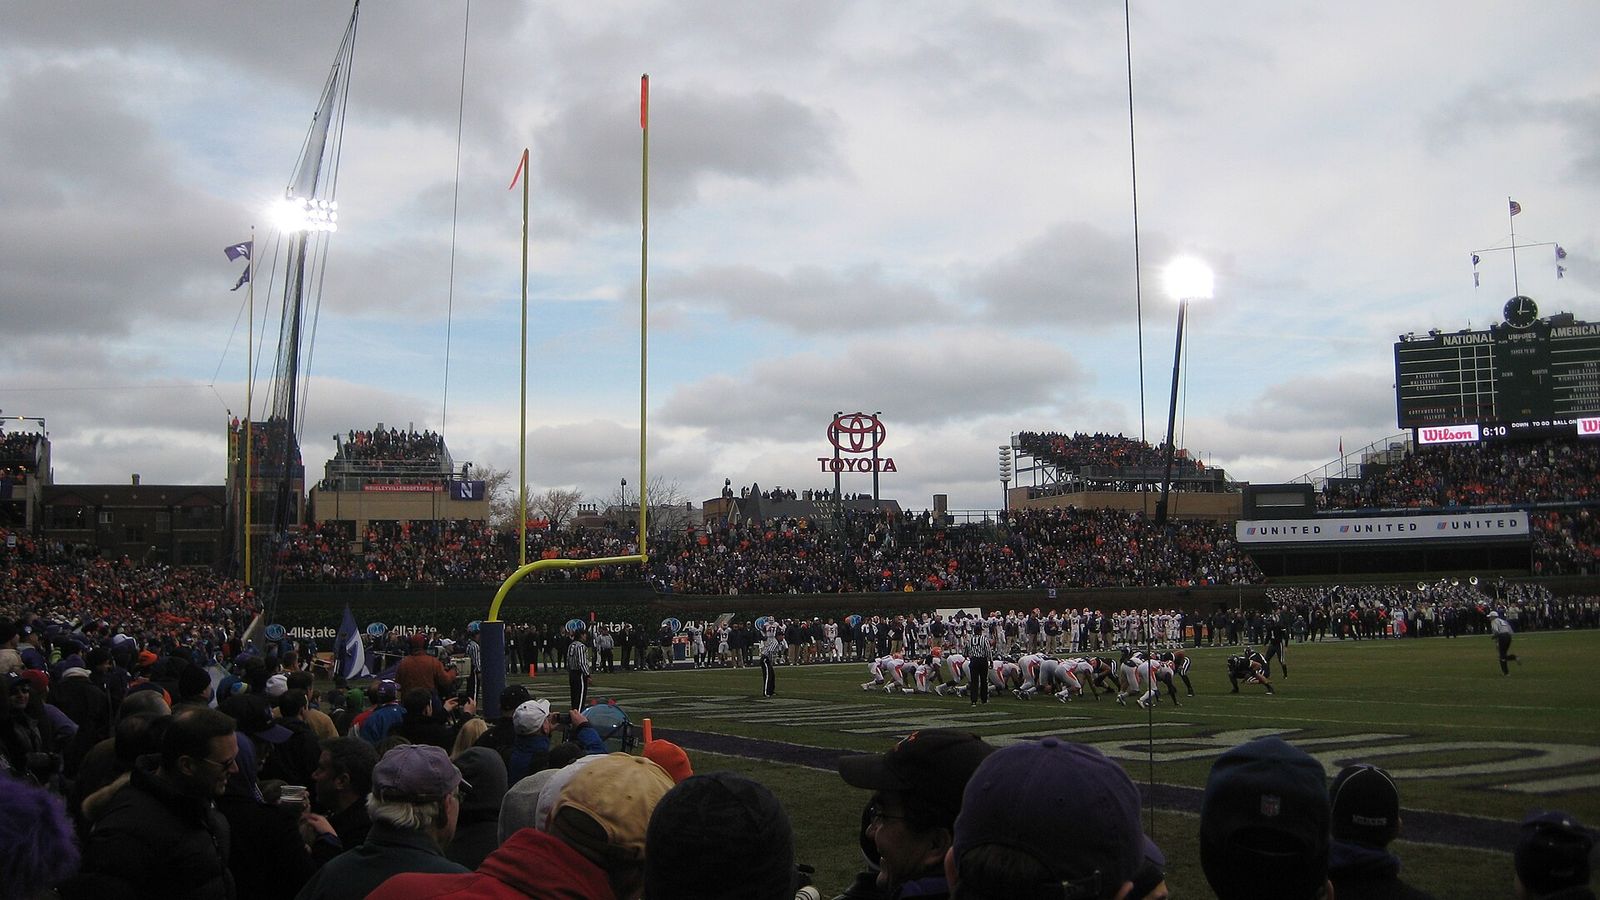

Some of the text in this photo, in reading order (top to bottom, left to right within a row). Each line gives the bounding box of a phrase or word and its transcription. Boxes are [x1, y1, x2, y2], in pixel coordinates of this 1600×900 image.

[1443, 333, 1495, 346] NATIONAL
[1423, 429, 1473, 441] Wilson
[1482, 427, 1506, 437] 6:10
[817, 458, 898, 472] TOYOTA
[461, 482, 473, 498] N
[1260, 525, 1321, 535] UNITED
[1354, 523, 1417, 533] UNITED
[1452, 519, 1517, 529] UNITED
[288, 626, 337, 638] Allstate
